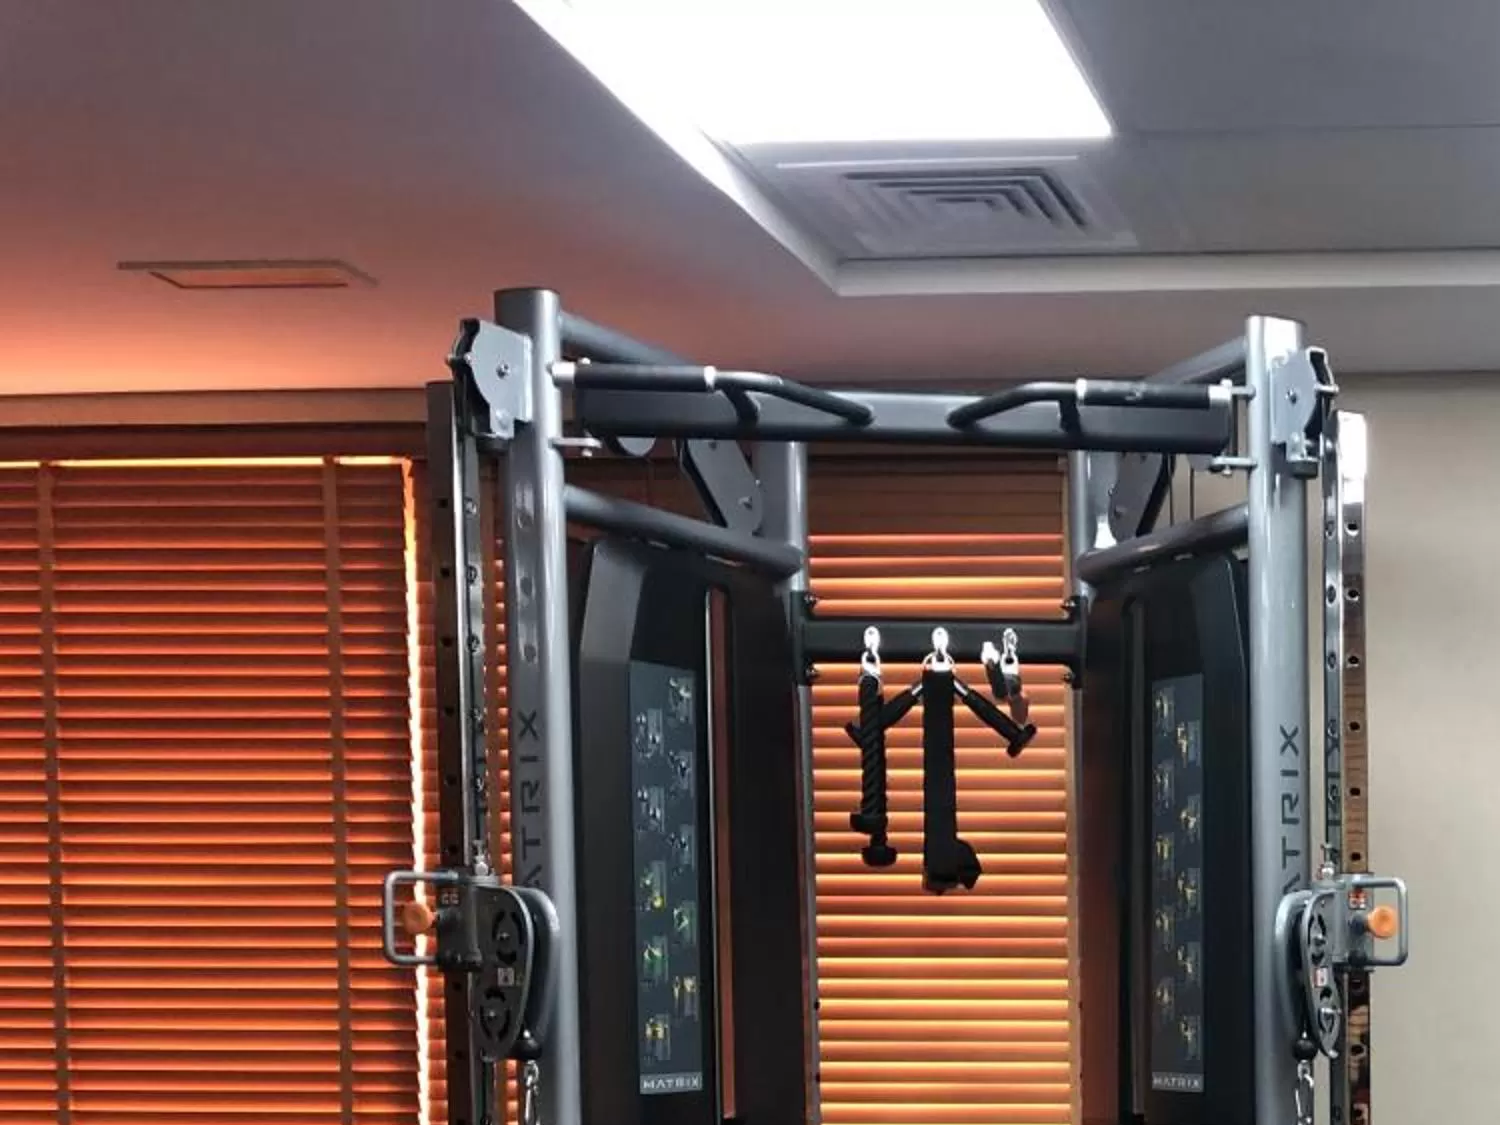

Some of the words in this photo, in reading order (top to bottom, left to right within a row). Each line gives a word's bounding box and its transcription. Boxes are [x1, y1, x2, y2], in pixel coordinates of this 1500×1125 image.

[517, 710, 542, 888] ATRIX
[1279, 724, 1301, 895] ATRIX
[643, 1076, 699, 1089] MATRIX
